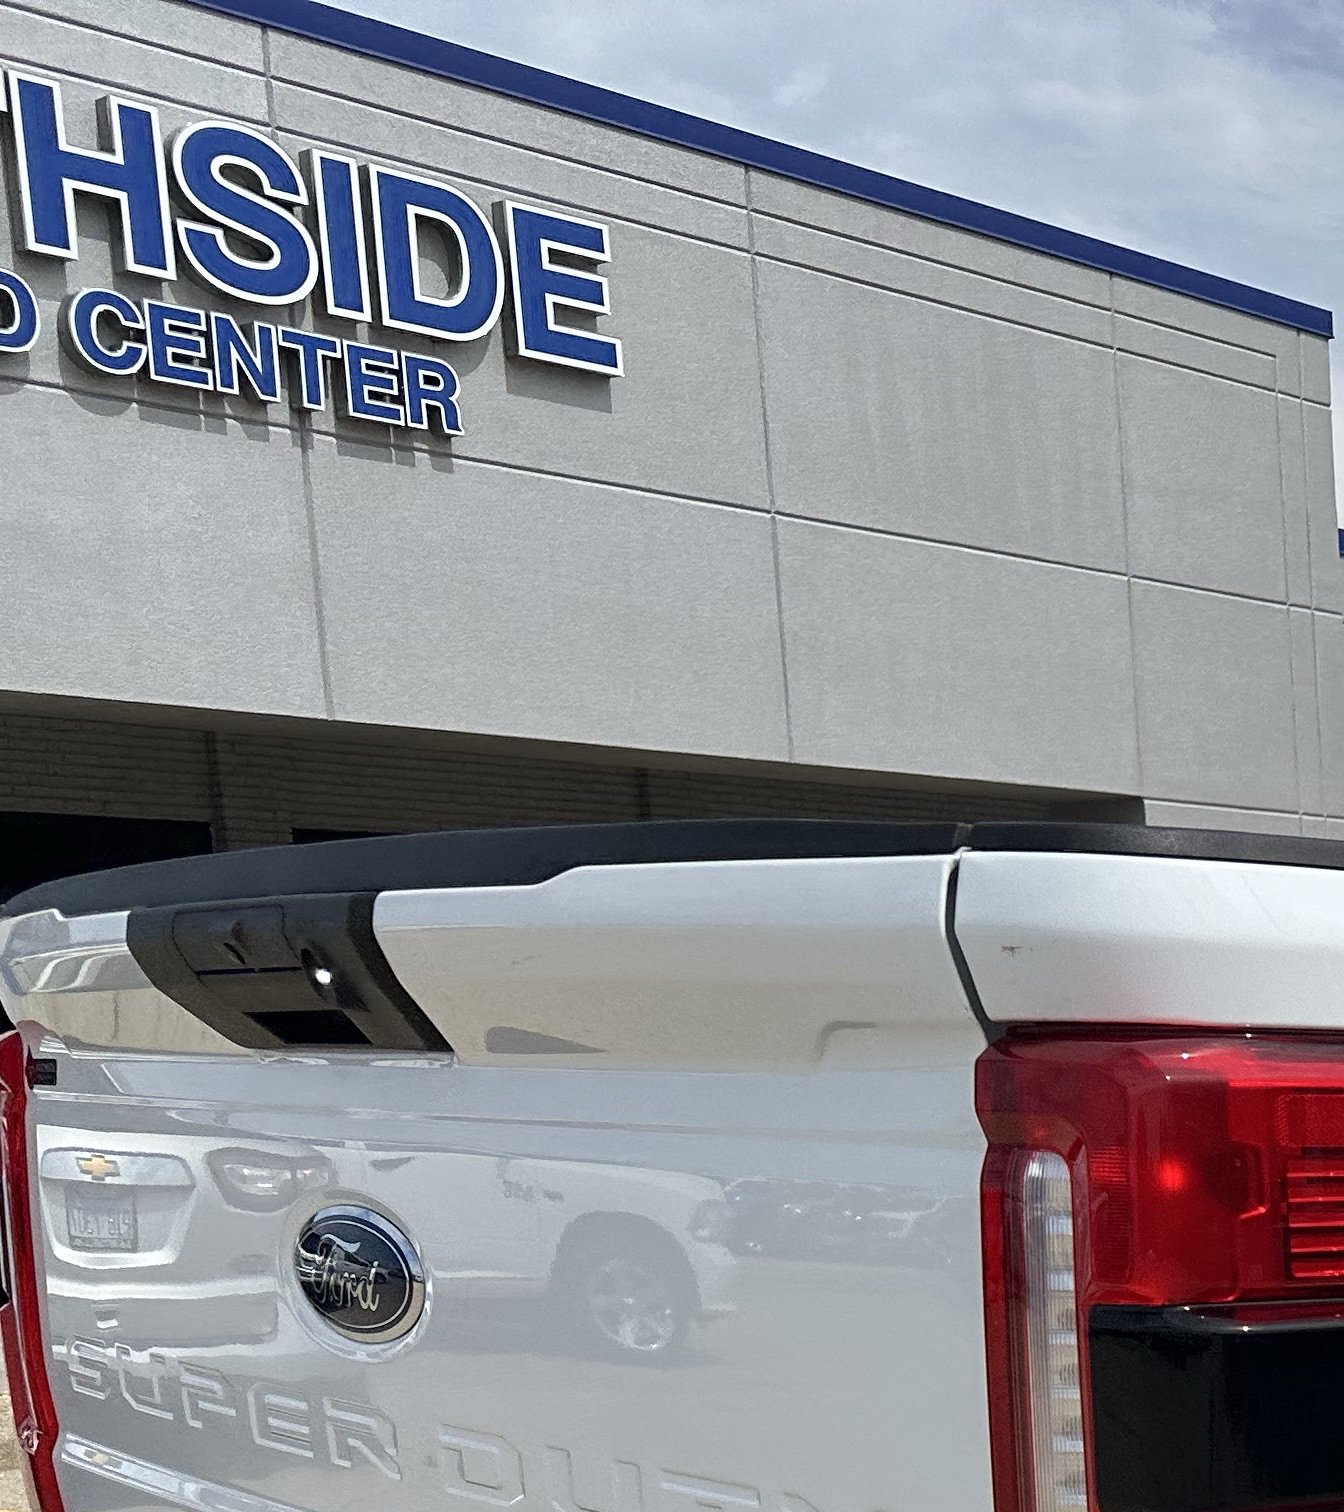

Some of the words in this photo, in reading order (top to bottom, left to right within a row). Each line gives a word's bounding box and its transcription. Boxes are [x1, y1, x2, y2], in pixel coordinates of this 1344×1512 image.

[0, 65, 625, 378] HSIDE
[69, 285, 465, 437] CENTER
[308, 1232, 380, 1312] Ford
[66, 1335, 402, 1480] SUPER
